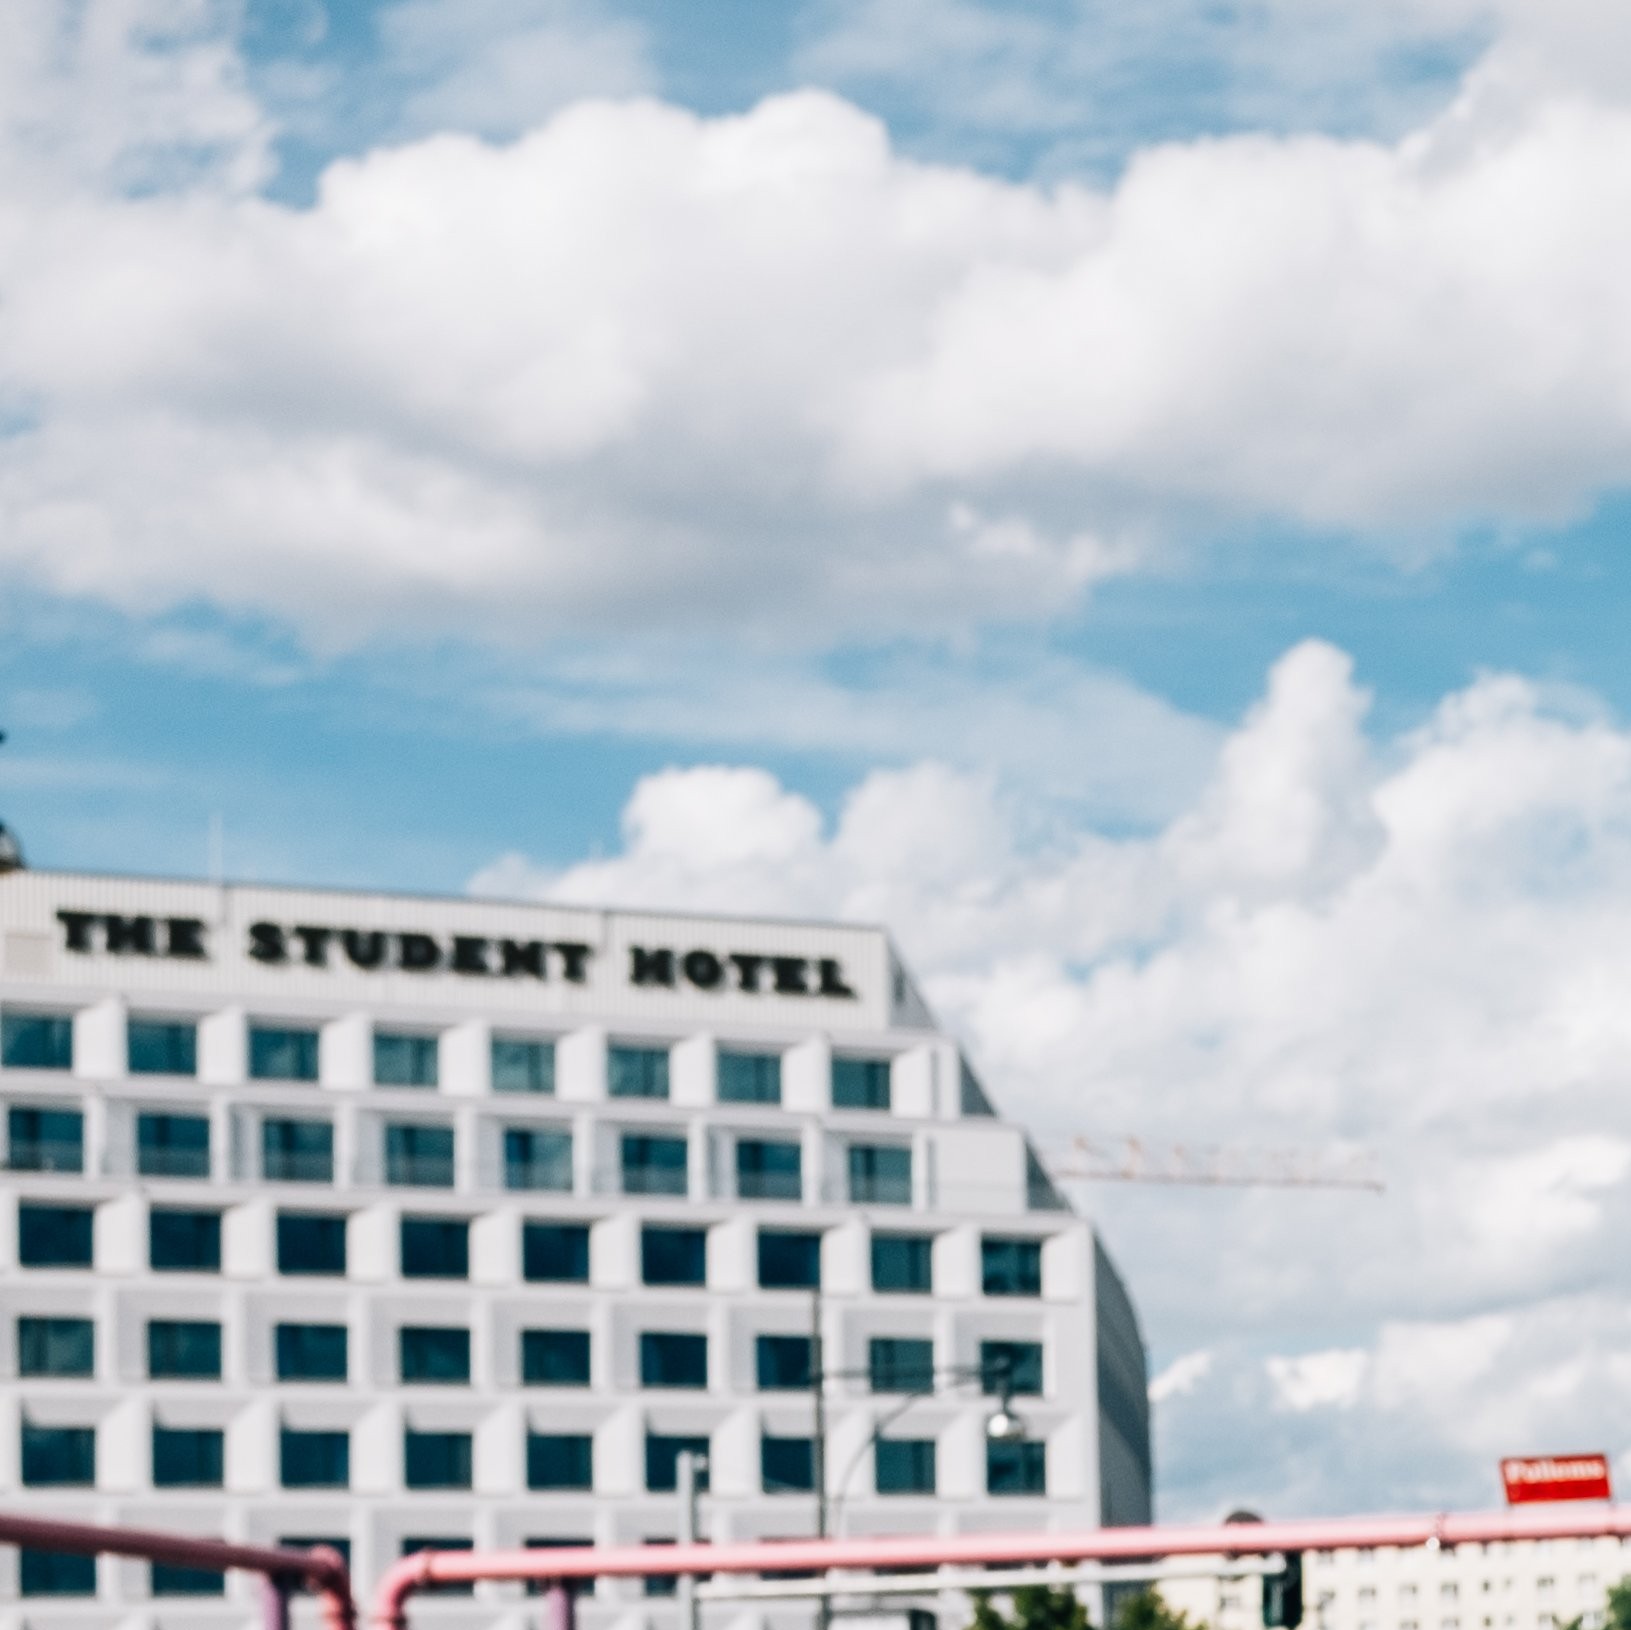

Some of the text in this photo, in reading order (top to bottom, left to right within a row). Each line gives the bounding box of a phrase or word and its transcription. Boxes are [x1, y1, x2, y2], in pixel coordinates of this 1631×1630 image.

[57, 909, 862, 1000] THE STUDENT HOTEL
